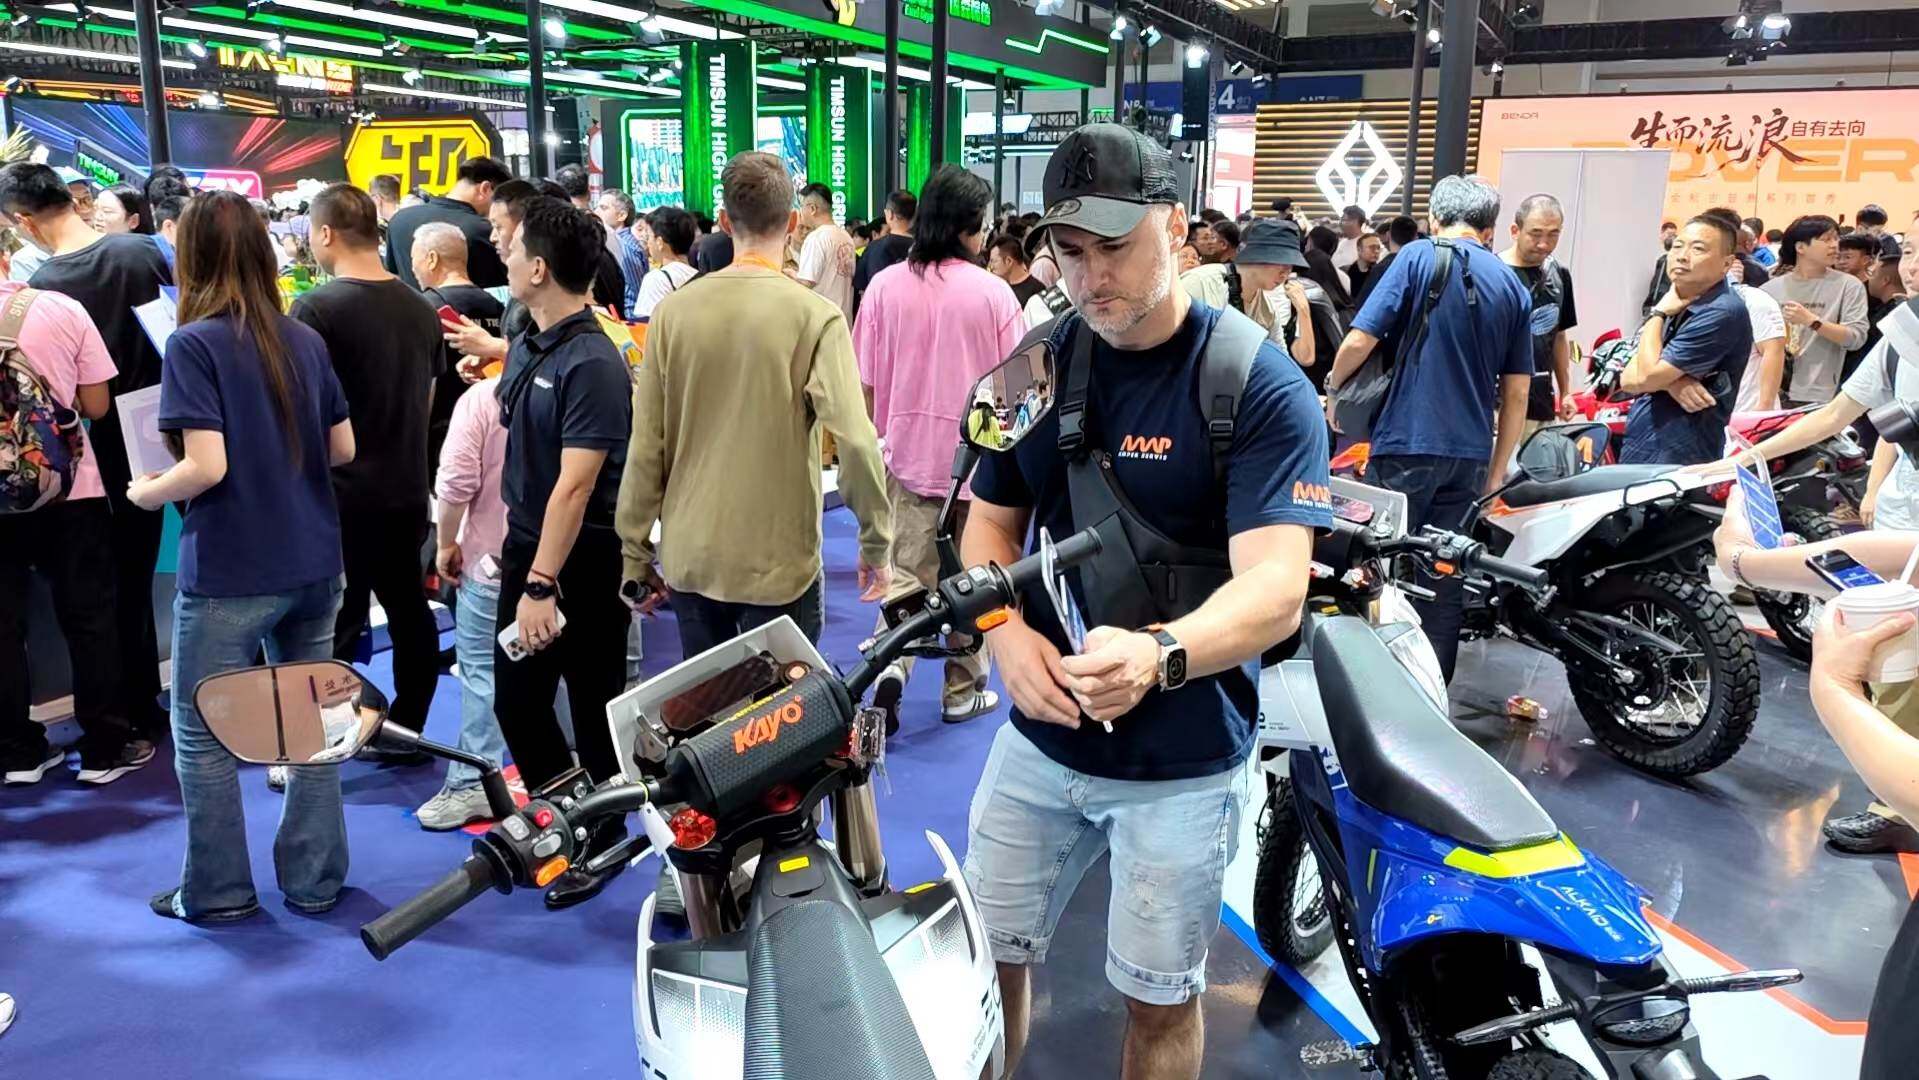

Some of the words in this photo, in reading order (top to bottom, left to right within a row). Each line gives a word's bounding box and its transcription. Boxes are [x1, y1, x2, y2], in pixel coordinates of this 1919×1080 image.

[709, 53, 726, 128] TIMSUN
[830, 75, 845, 142] TIMSUN
[711, 132, 728, 180] HIGH
[831, 145, 846, 187] HIGH
[1631, 107, 1820, 178] 生而流浪
[1790, 119, 1866, 137] 自有去向
[734, 702, 803, 754] KAYO
[1560, 886, 1609, 927] ALKAID
